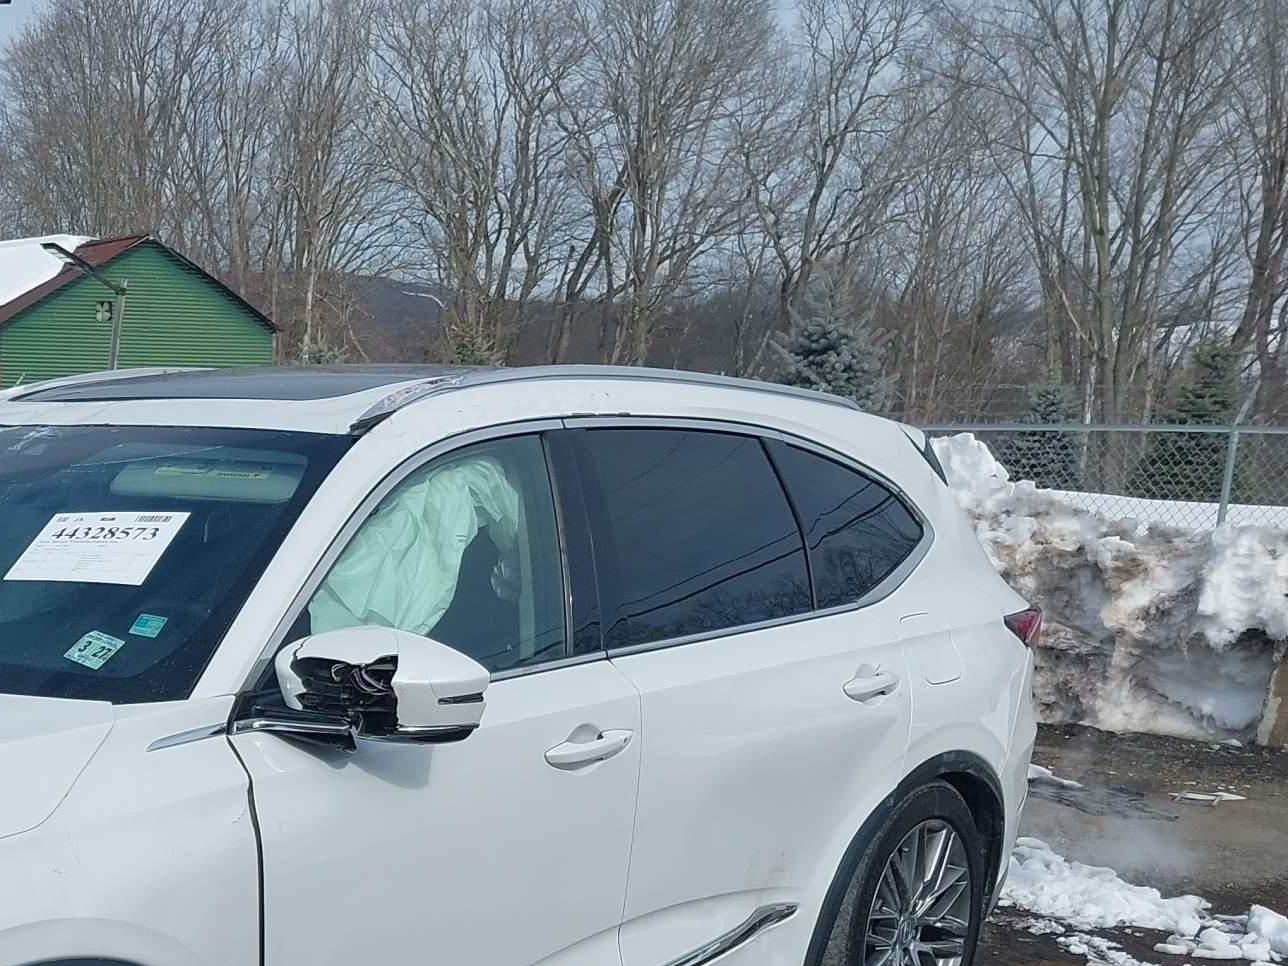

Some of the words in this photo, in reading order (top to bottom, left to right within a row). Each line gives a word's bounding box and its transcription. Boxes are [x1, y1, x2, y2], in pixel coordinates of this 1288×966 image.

[51, 526, 160, 540] 44328573
[78, 640, 92, 652] 3
[91, 645, 112, 659] 27
